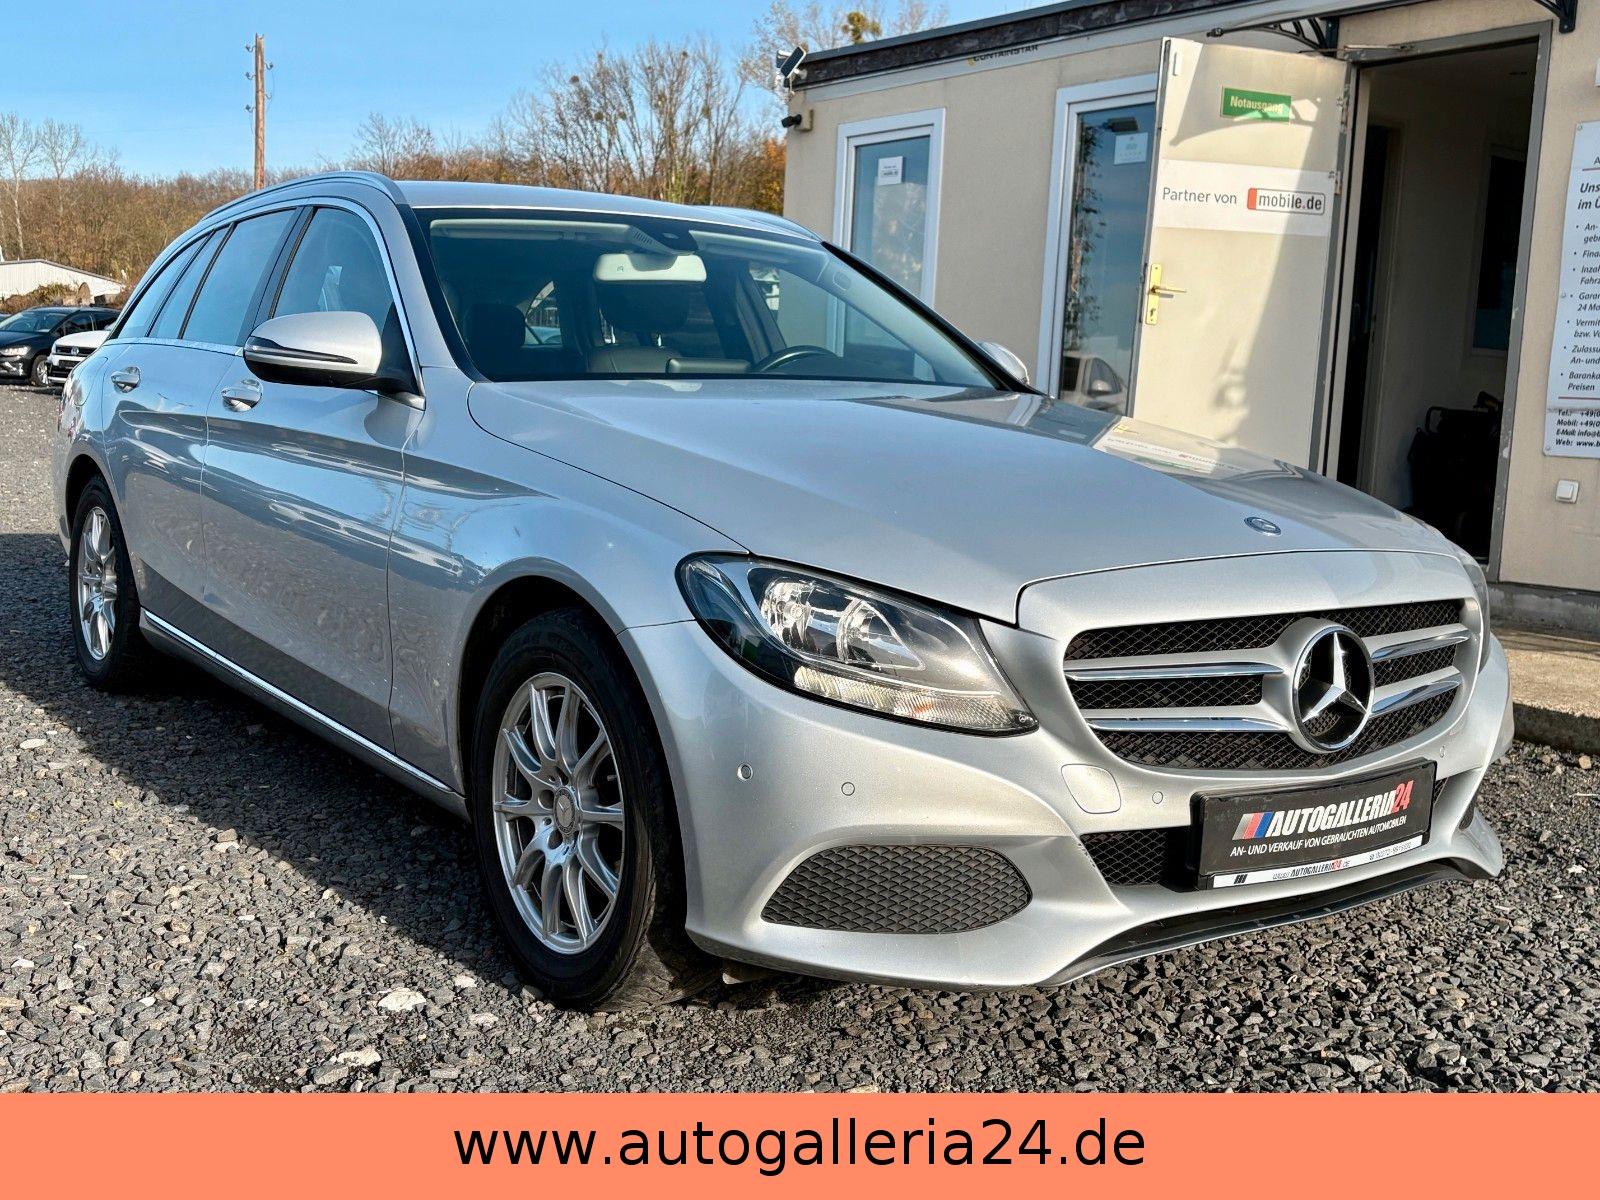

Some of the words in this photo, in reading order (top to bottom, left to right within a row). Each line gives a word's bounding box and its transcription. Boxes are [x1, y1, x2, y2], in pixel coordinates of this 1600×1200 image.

[1230, 95, 1284, 114] Notausgang
[1162, 187, 1211, 203] Partner
[1214, 193, 1237, 204] von
[1258, 192, 1322, 211] mobile.de
[1577, 199, 1592, 210] im
[1584, 222, 1599, 231] An-
[1577, 303, 1587, 311] 24
[1570, 356, 1584, 364] An-
[1585, 356, 1600, 364] und
[1568, 382, 1595, 391] Preisen
[1556, 419, 1578, 427] Mobil:
[1555, 438, 1573, 446] Web:
[1265, 780, 1415, 838] AUTOGALLERIA24
[1230, 846, 1247, 857] AN-
[1248, 843, 1268, 857] UND
[1267, 839, 1304, 854] VERKAUF
[1304, 835, 1321, 849] VON
[1321, 826, 1369, 846] GEBRAUCHTEN
[1367, 814, 1407, 838] AUTOMOBILEN
